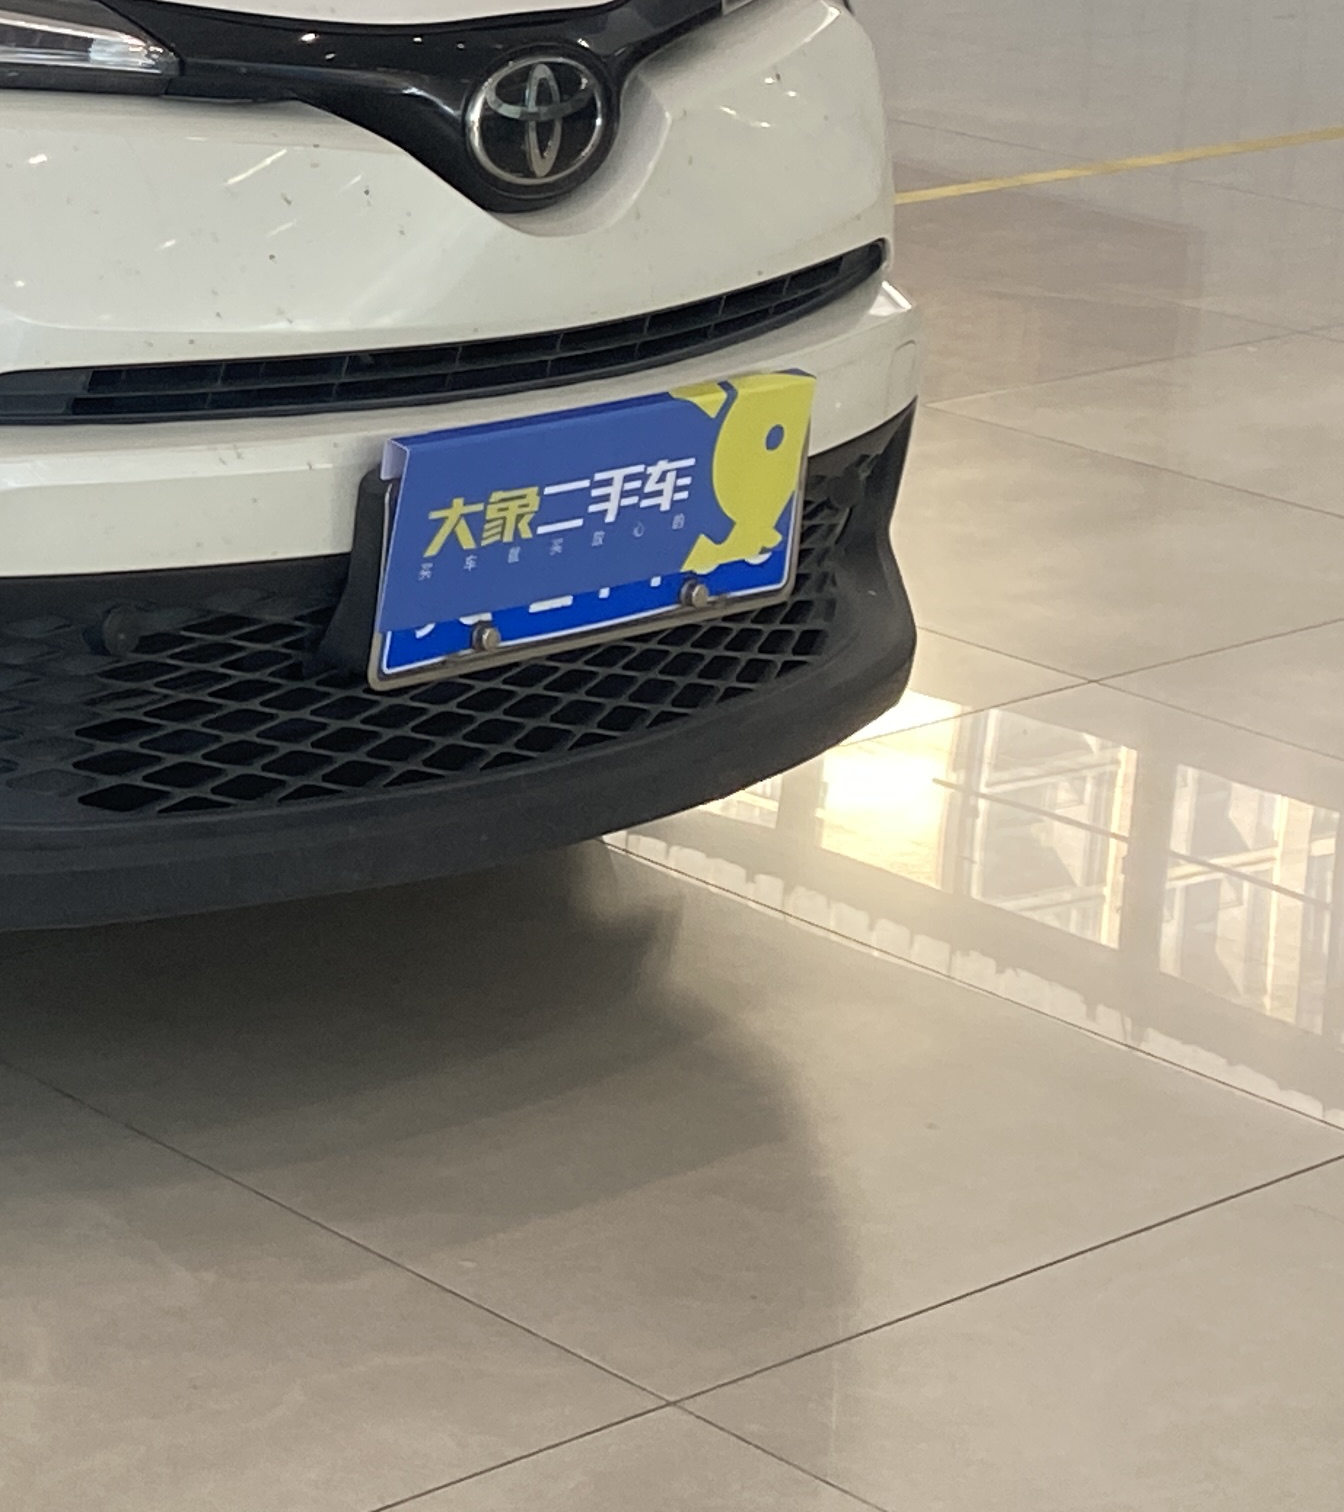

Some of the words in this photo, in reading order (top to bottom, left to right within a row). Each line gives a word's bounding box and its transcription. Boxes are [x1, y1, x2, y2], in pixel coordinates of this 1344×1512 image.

[423, 457, 697, 558] 大象二手车
